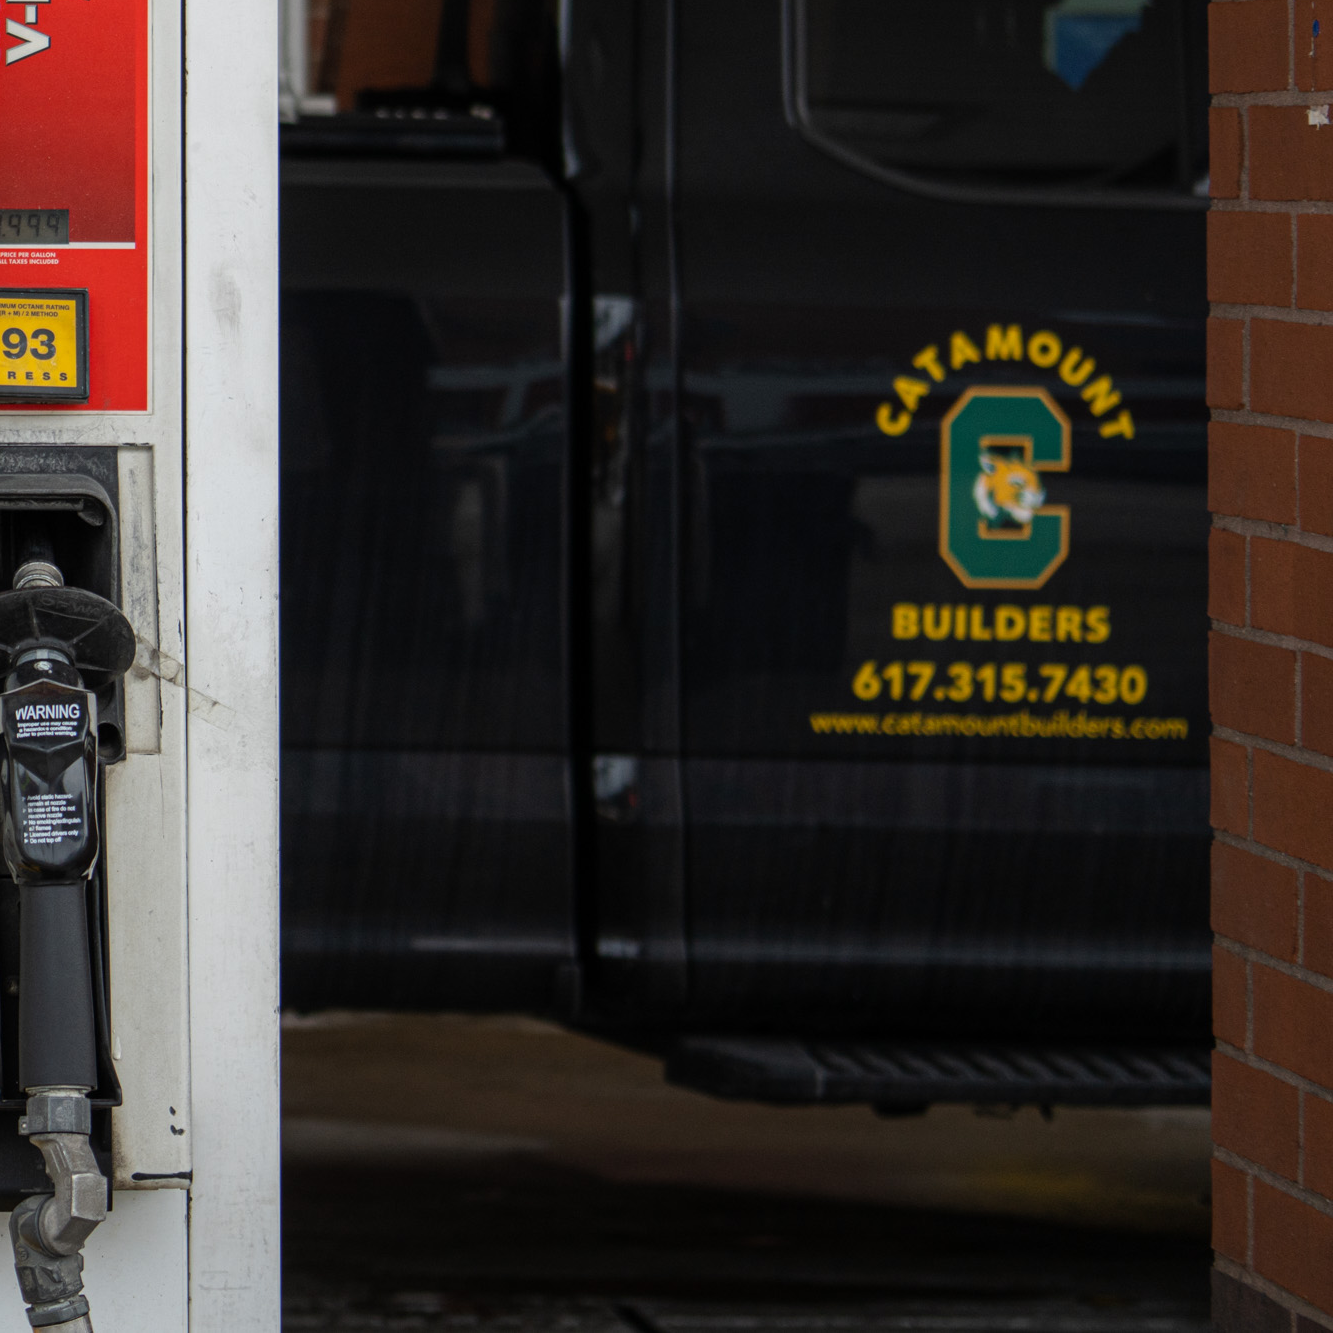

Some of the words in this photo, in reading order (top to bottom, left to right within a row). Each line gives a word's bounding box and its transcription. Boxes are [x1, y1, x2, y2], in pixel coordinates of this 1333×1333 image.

[2, 327, 56, 360] 93
[876, 323, 1135, 440] CATAMOUNT
[892, 603, 1111, 642] BUILDERS
[852, 661, 1147, 704] 617.315.7430
[15, 704, 80, 720] WARNING
[810, 711, 1188, 740] www.catamountbuilders.com
